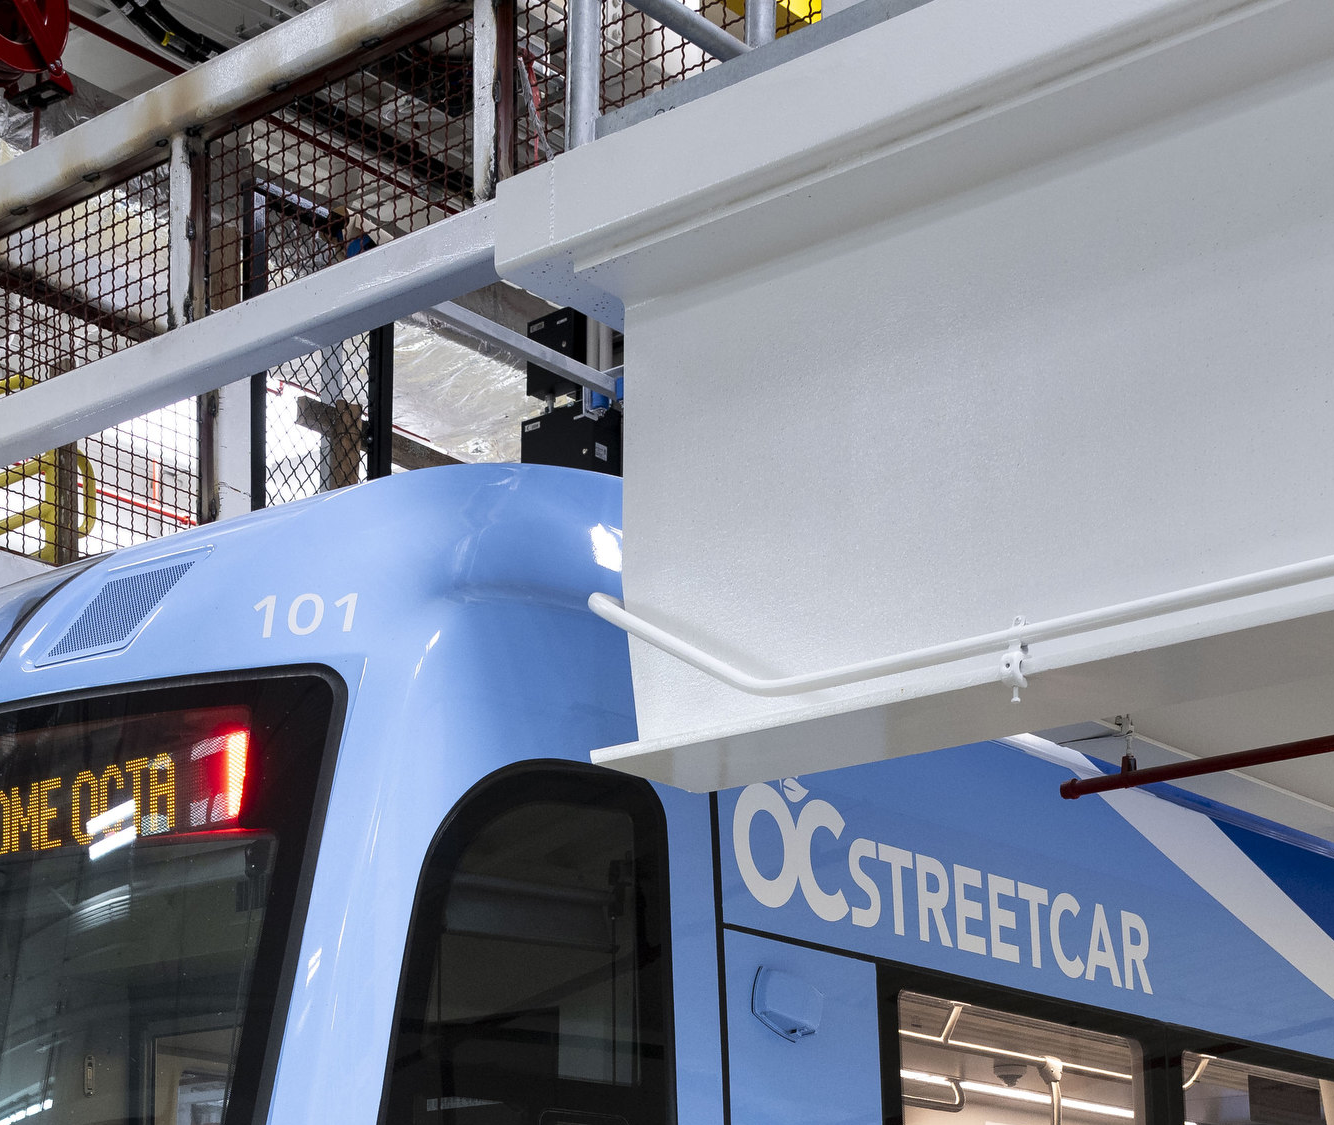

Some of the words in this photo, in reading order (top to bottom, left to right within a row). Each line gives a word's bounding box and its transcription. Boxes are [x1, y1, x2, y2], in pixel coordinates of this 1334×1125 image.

[252, 592, 358, 638] 101
[71, 752, 176, 846] OCTA
[847, 837, 1154, 996] STREETCAR
